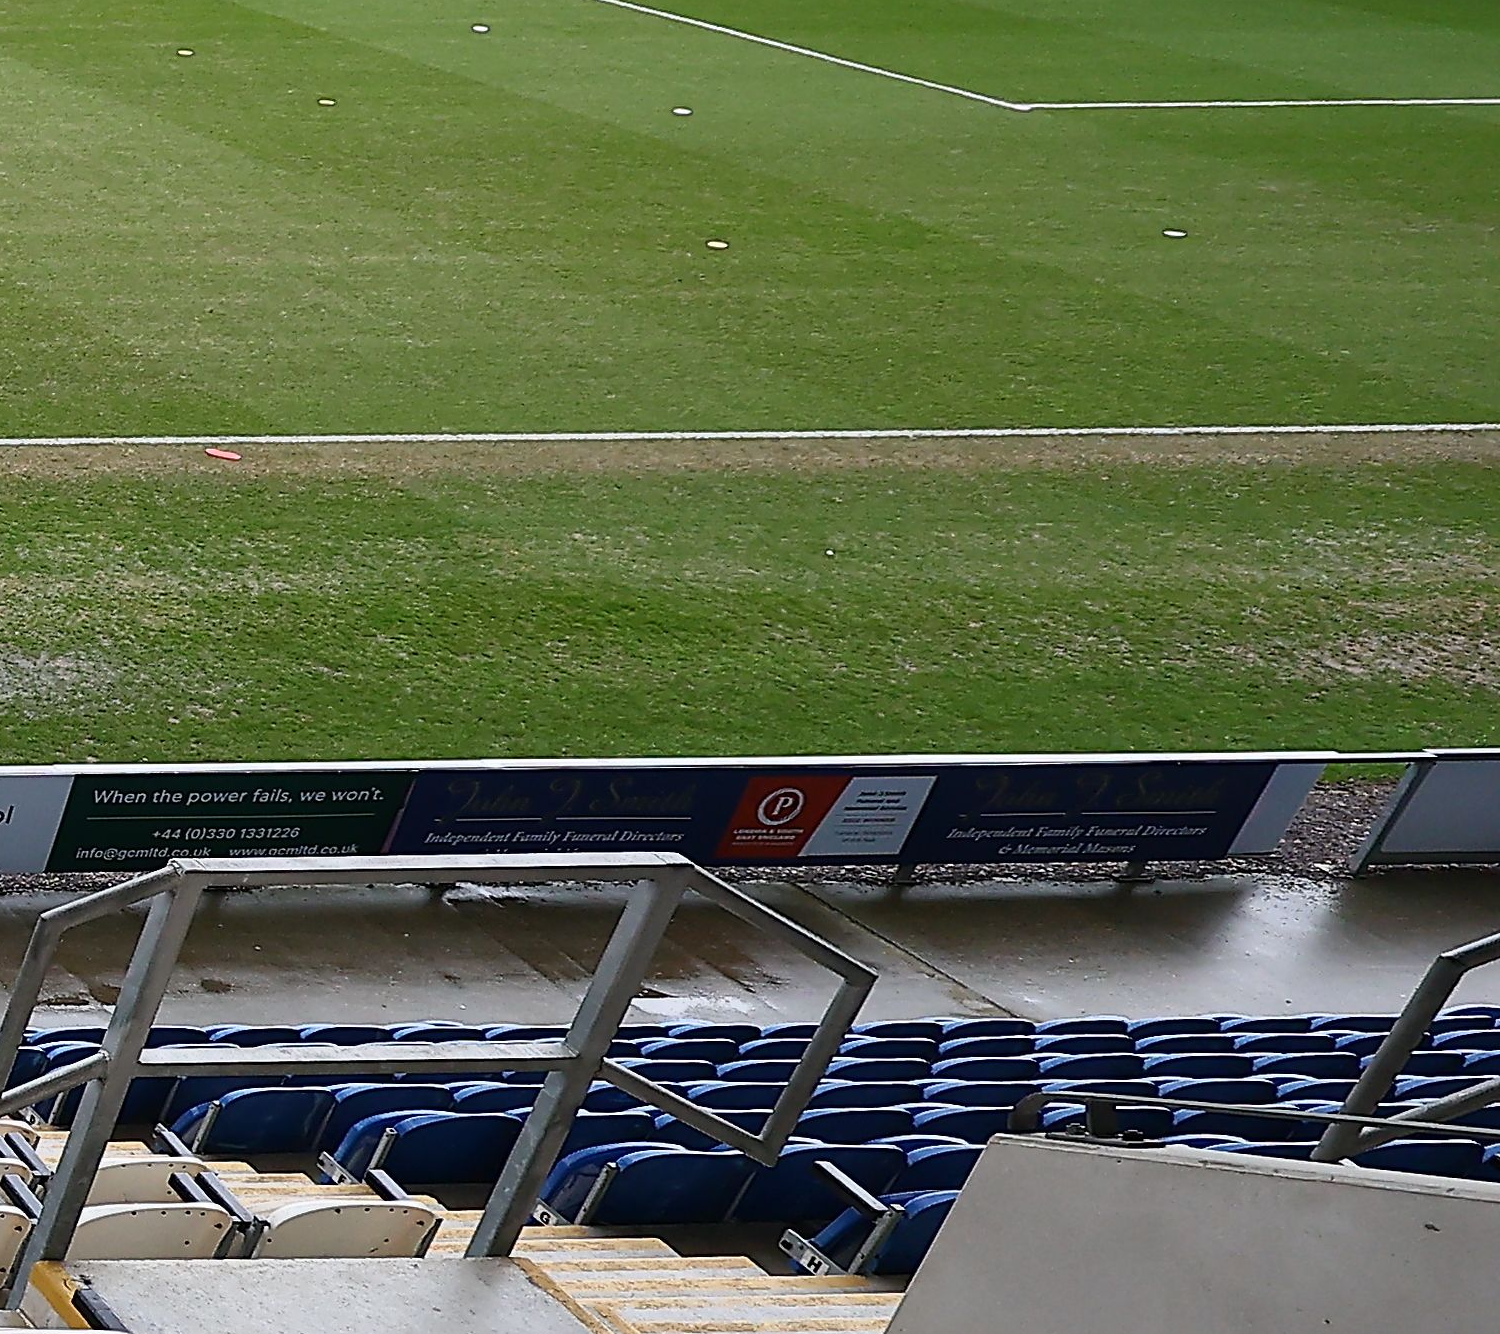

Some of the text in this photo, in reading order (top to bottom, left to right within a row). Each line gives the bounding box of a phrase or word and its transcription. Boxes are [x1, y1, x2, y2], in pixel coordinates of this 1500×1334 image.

[92, 787, 385, 809] When the power fails, we won't.
[151, 826, 302, 844] +44 (0)330 1331226
[423, 830, 686, 849] Independent Family Funeral Directors
[945, 824, 1210, 843] Independent Family Funeral Directors
[75, 845, 212, 863] info@gcmltd.co.uk
[1011, 841, 1082, 857] Memorial
